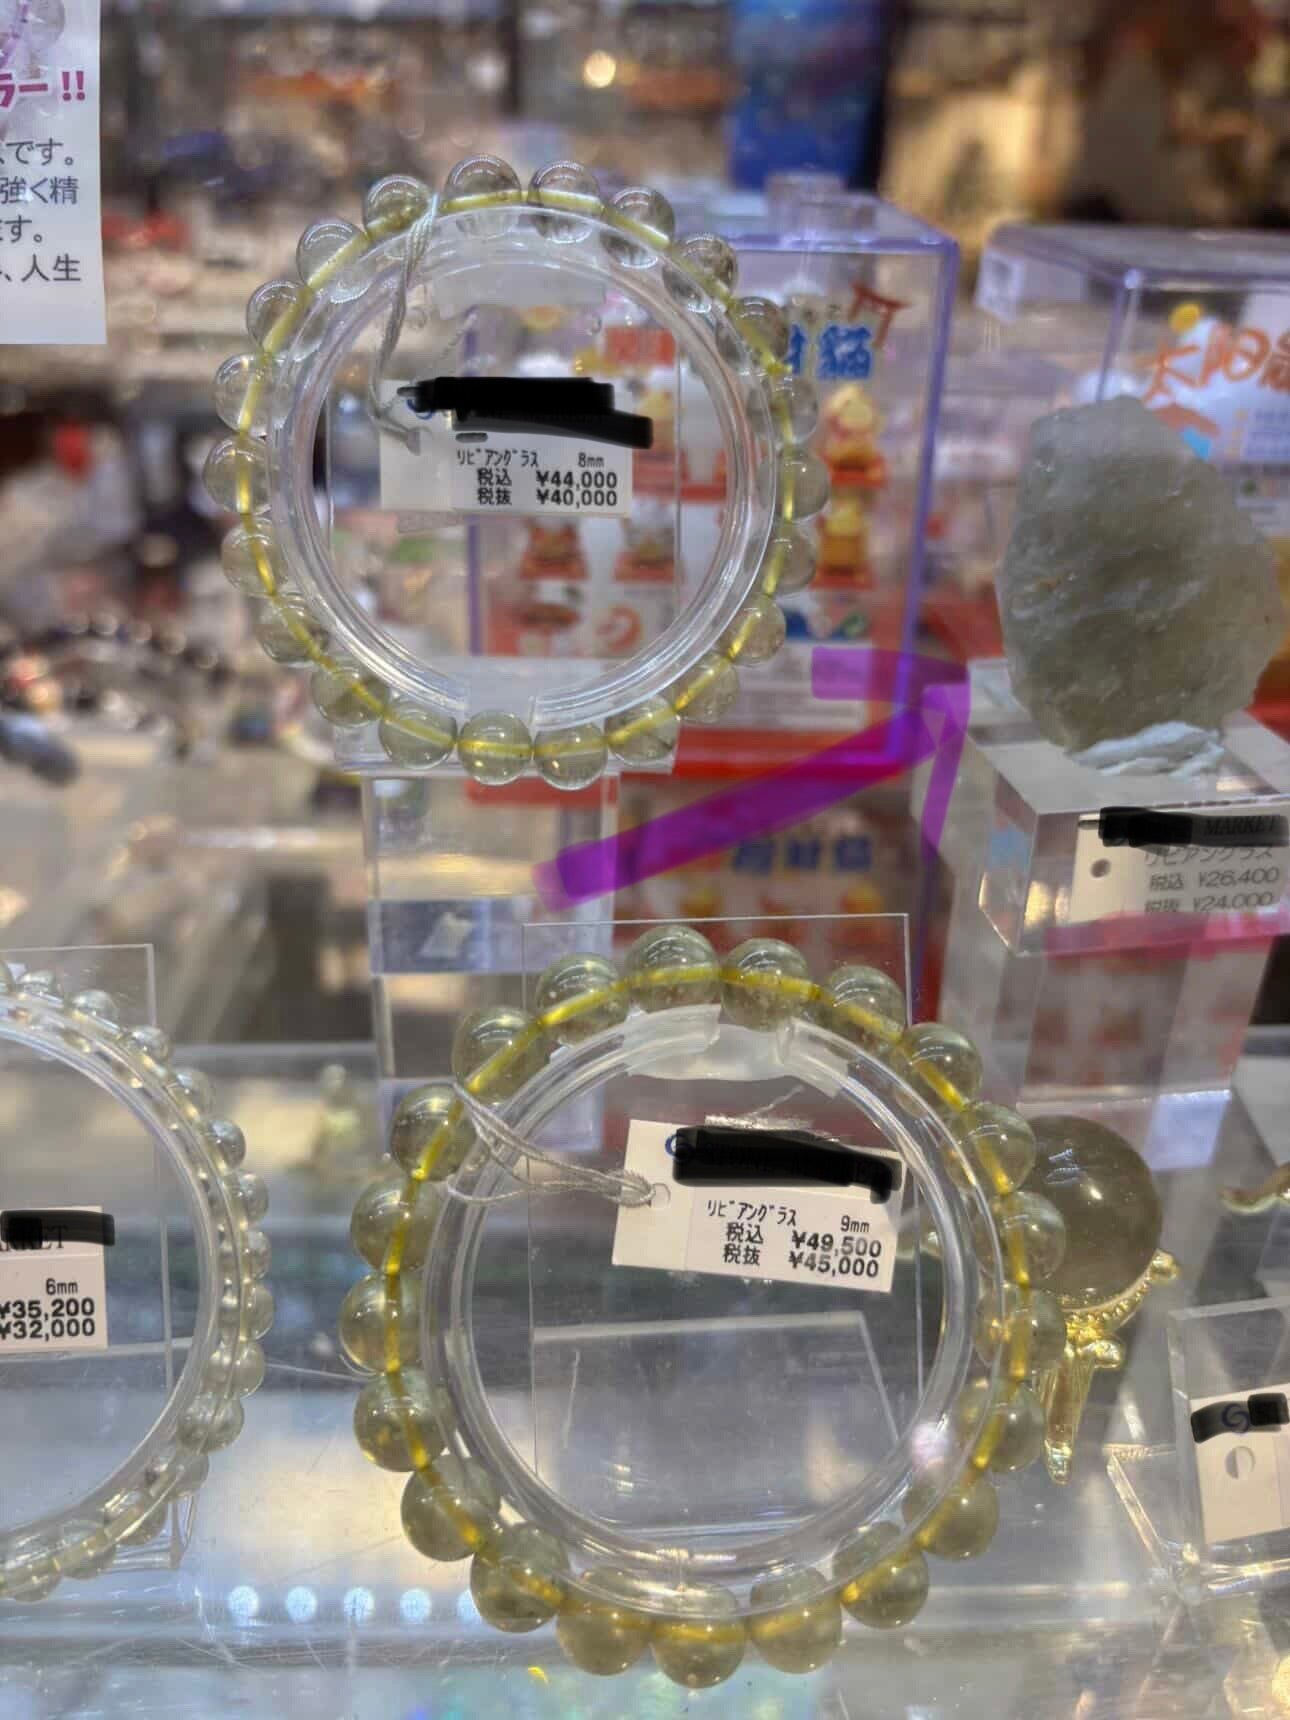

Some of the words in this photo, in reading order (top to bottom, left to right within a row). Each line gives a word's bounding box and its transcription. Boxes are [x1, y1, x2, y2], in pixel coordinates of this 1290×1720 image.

[0, 137, 73, 166] です。
[0, 214, 43, 243] す。
[0, 253, 82, 282] 、人生
[578, 452, 605, 468] 8mm
[477, 468, 512, 487] 税込
[536, 470, 618, 491] ¥44,000
[477, 488, 512, 506] 税抜
[536, 489, 618, 509] ¥40,000
[840, 1215, 870, 1233] 9mm
[725, 1222, 764, 1245] 税込
[791, 1230, 882, 1258] ¥49,500
[722, 1243, 760, 1266] 税抜
[788, 1250, 879, 1278] ¥45,000
[45, 1277, 79, 1295] 6mm
